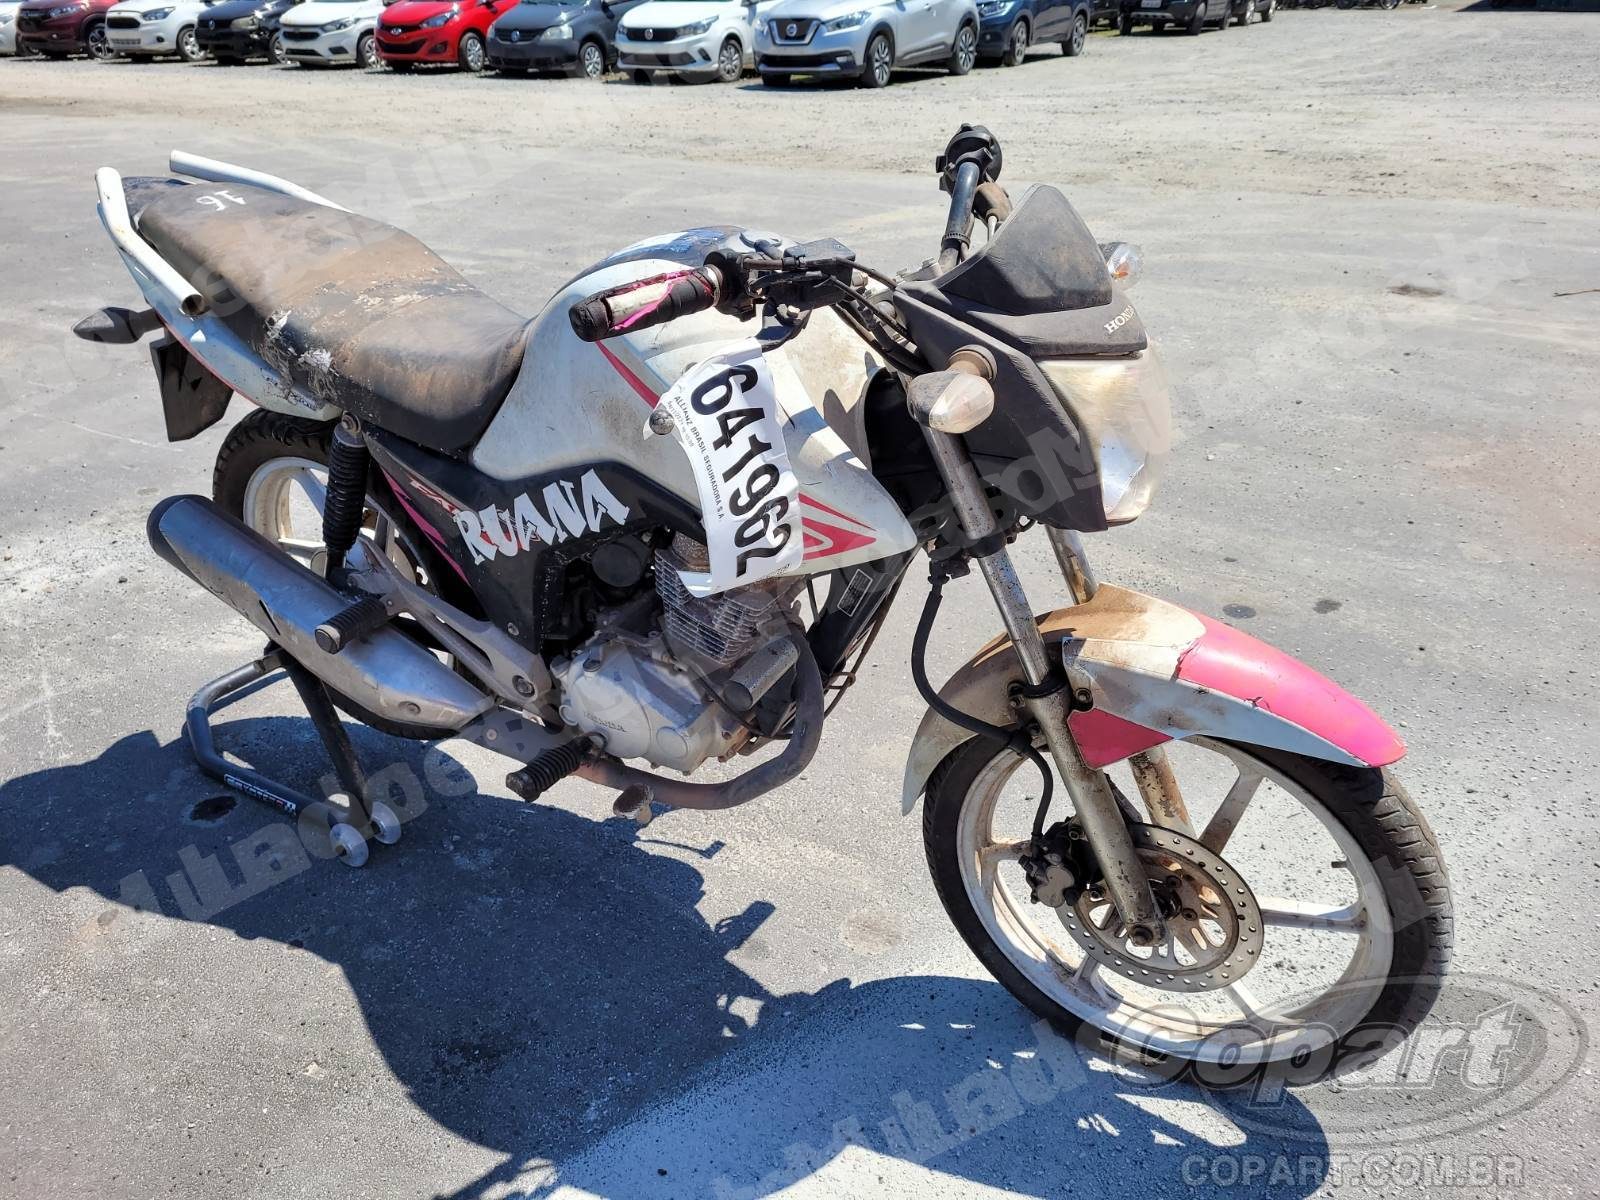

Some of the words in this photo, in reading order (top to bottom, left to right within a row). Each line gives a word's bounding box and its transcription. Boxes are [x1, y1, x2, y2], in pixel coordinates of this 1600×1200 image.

[673, 395, 693, 425] ALLIANZ
[690, 425, 708, 455] BRASIL
[690, 364, 793, 578] 641962
[452, 468, 631, 566] RUANA
